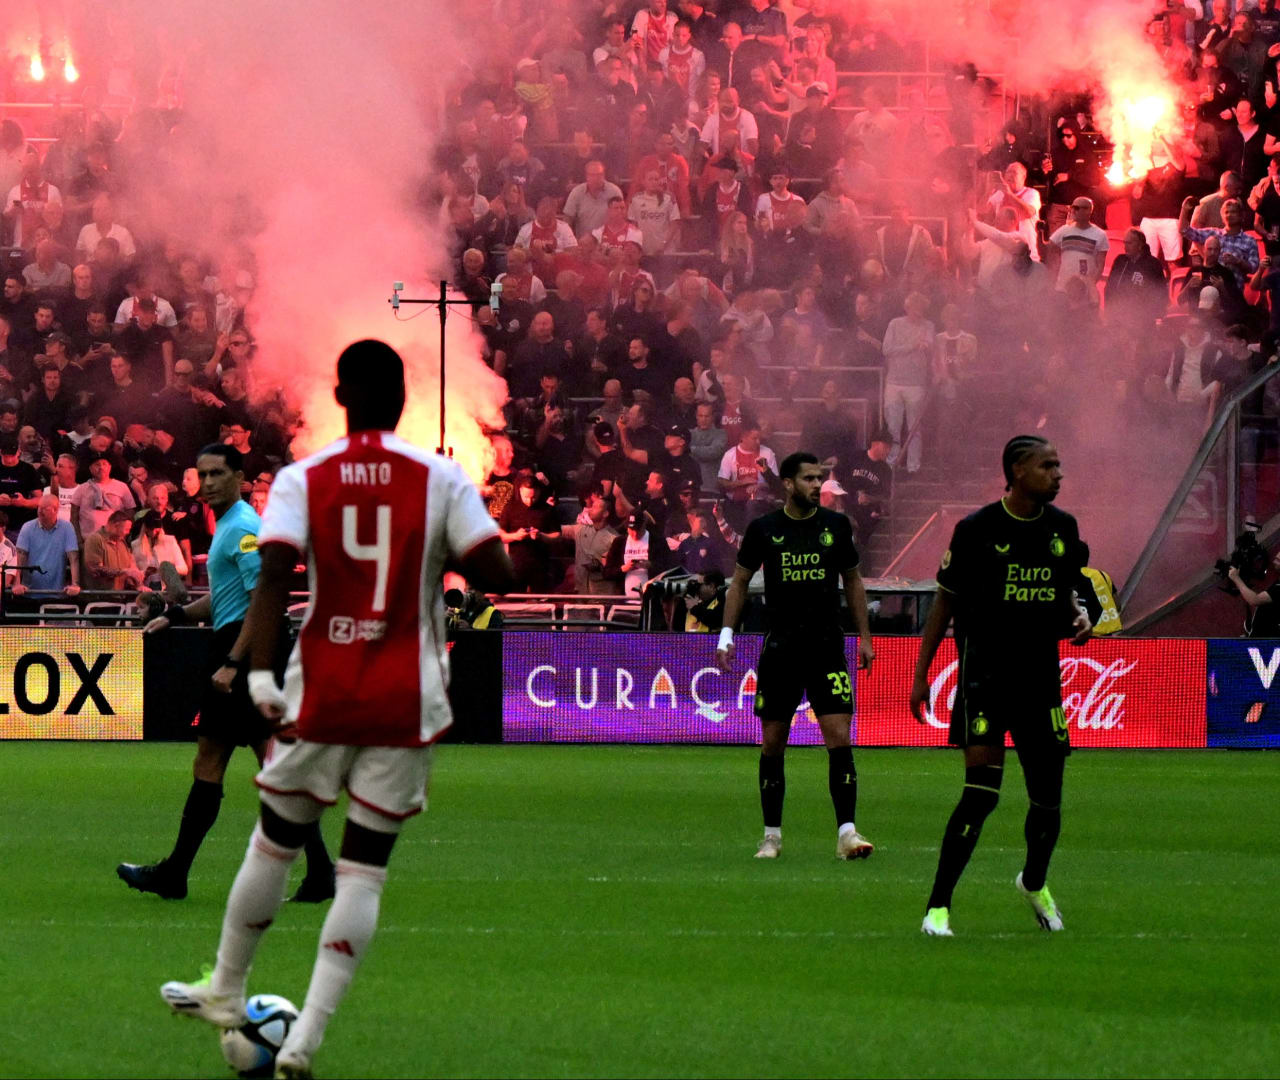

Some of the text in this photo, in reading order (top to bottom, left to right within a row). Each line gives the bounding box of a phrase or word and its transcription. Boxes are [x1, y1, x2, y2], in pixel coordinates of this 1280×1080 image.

[340, 461, 391, 486] HATO
[342, 504, 391, 612] 4
[781, 551, 820, 568] Euro
[781, 567, 826, 582] Parcs
[1007, 563, 1051, 582] Euro
[1003, 583, 1056, 602] Parcs
[526, 665, 760, 722] CURAÇA
[826, 670, 851, 695] 33
